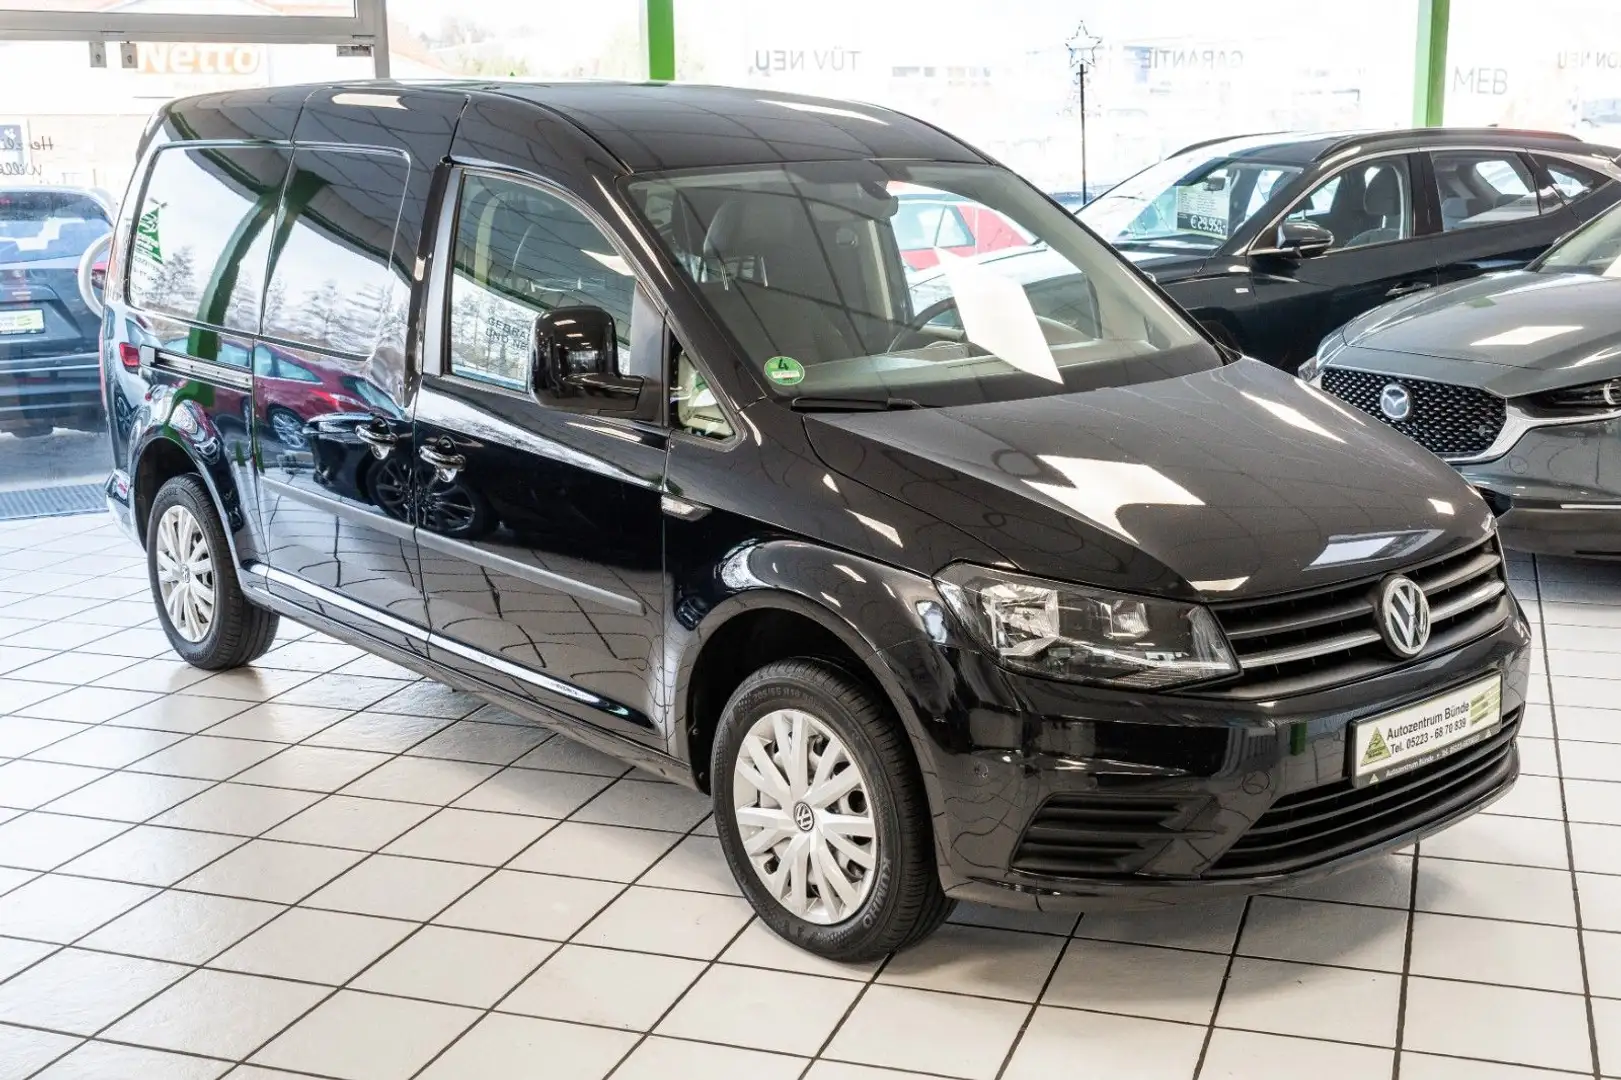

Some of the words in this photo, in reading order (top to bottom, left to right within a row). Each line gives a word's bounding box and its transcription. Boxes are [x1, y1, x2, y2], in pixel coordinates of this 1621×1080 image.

[136, 43, 260, 74] Netto
[778, 358, 789, 371] 4
[1383, 578, 1431, 654] VW
[1387, 714, 1442, 740] Autozentrum
[1445, 701, 1469, 719] Bünde
[1391, 742, 1403, 755] Tel.
[1407, 732, 1429, 749] 05223
[1434, 726, 1443, 739] 68
[1445, 723, 1453, 735] 70
[1454, 718, 1467, 731] 839
[863, 857, 892, 929] KUMHO
